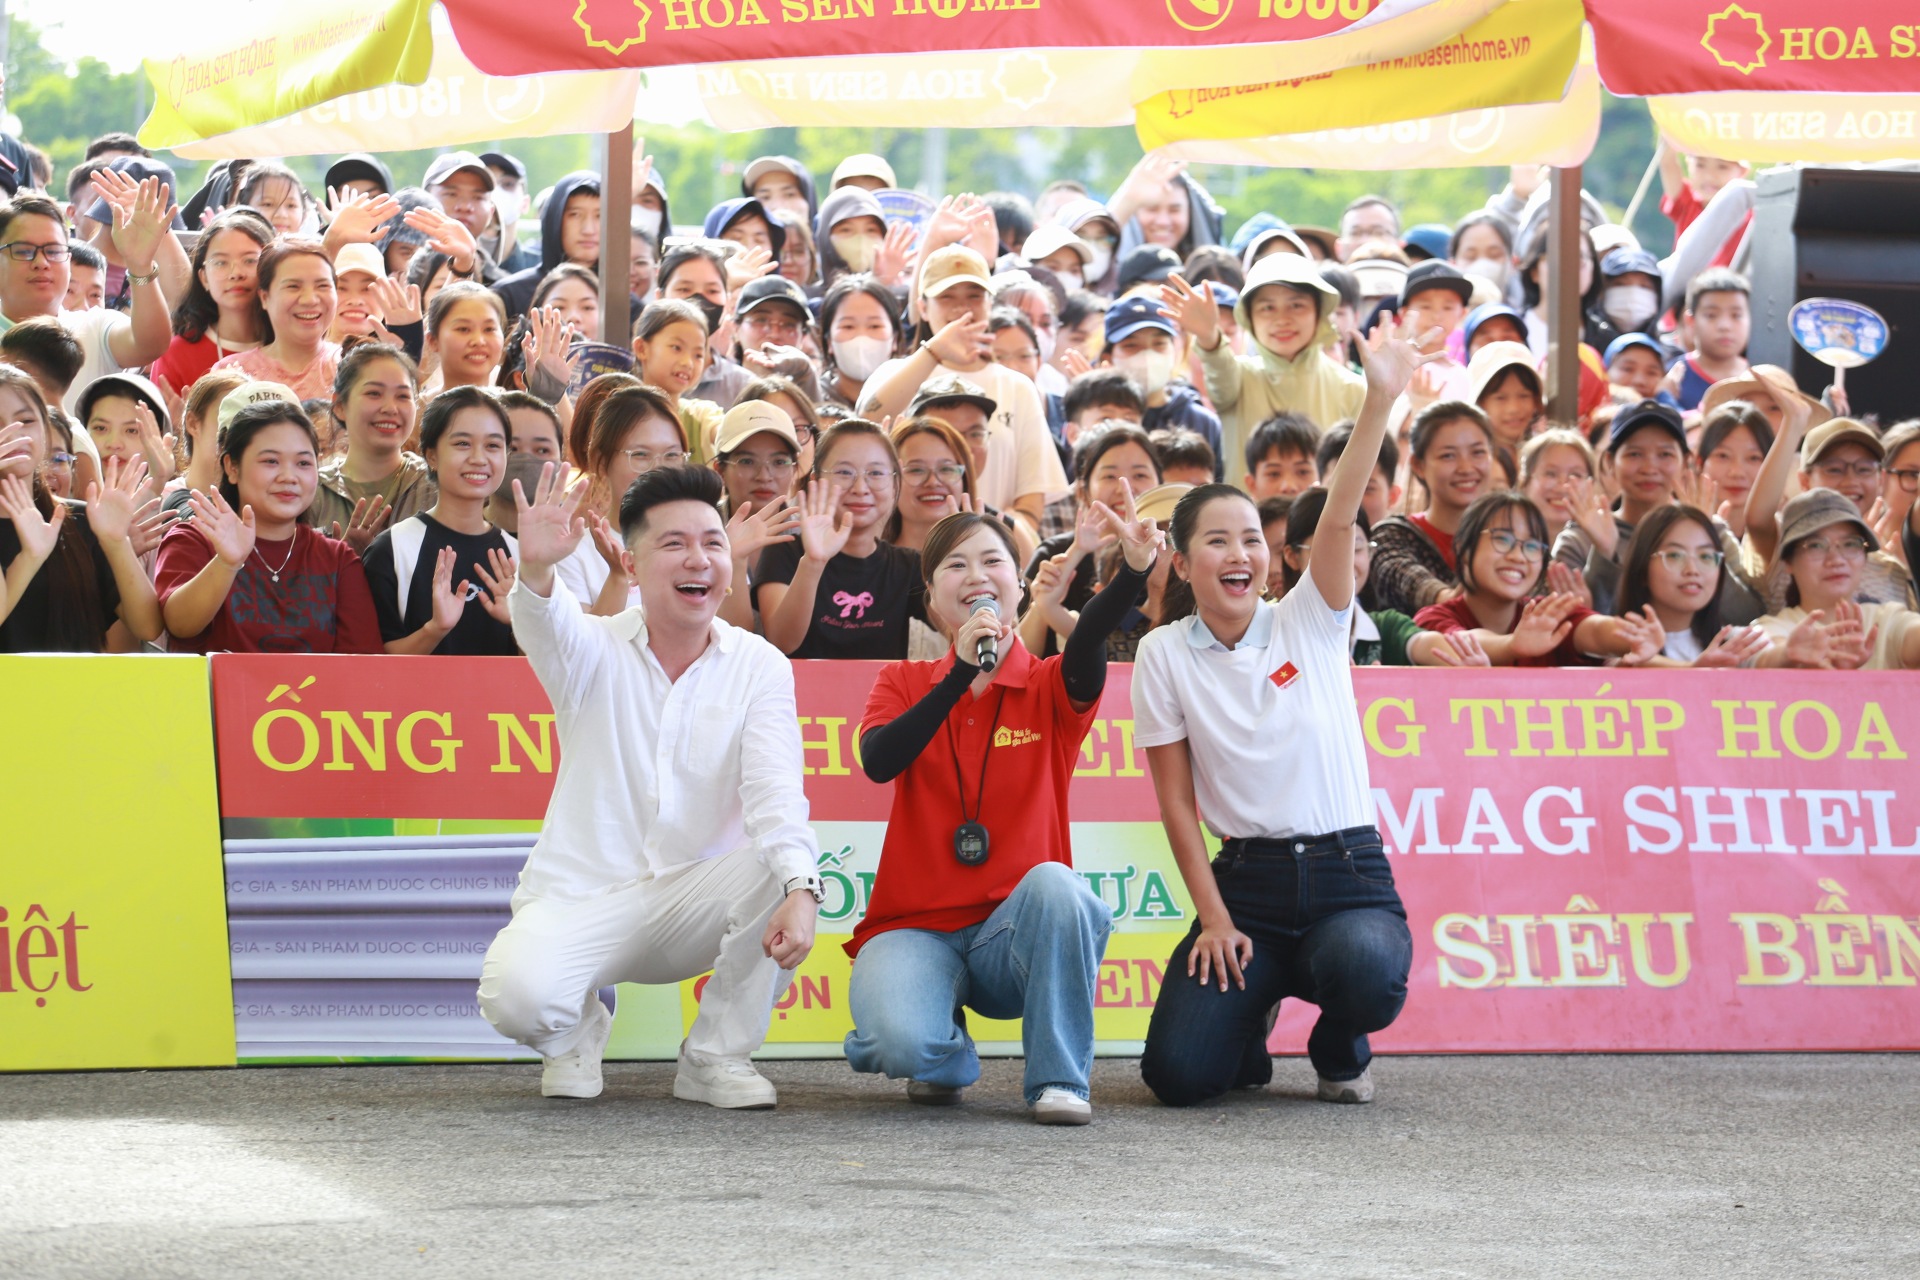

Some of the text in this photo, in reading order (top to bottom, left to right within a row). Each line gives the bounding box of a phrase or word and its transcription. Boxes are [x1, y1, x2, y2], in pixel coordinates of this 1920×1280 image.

[665, 0, 770, 30] HOA
[1779, 25, 1920, 60] HOA S
[186, 37, 277, 95] HOA SEN HOME
[248, 391, 284, 403] PARIS
[252, 675, 463, 774] ỐNG
[797, 716, 864, 776] H
[1450, 683, 1685, 758] THÉP
[1712, 699, 1908, 760] HOA
[1369, 785, 1920, 856] MAG SHIEL
[248, 880, 277, 893] GIA
[291, 879, 322, 892] SAN
[327, 879, 372, 891] PHAM
[378, 878, 425, 891] DUOC
[430, 877, 489, 890] CHUNG
[231, 942, 260, 954] GIA
[275, 942, 306, 954] SAN
[312, 942, 360, 954] PHAM
[366, 942, 417, 954] DUOC
[422, 942, 487, 954] CHUNG
[1432, 878, 1920, 991] SIÊU BỀN
[247, 1004, 276, 1017] GIA
[290, 1004, 321, 1017] SAN
[327, 1004, 374, 1017] PHAM
[380, 1004, 429, 1017] DUOC
